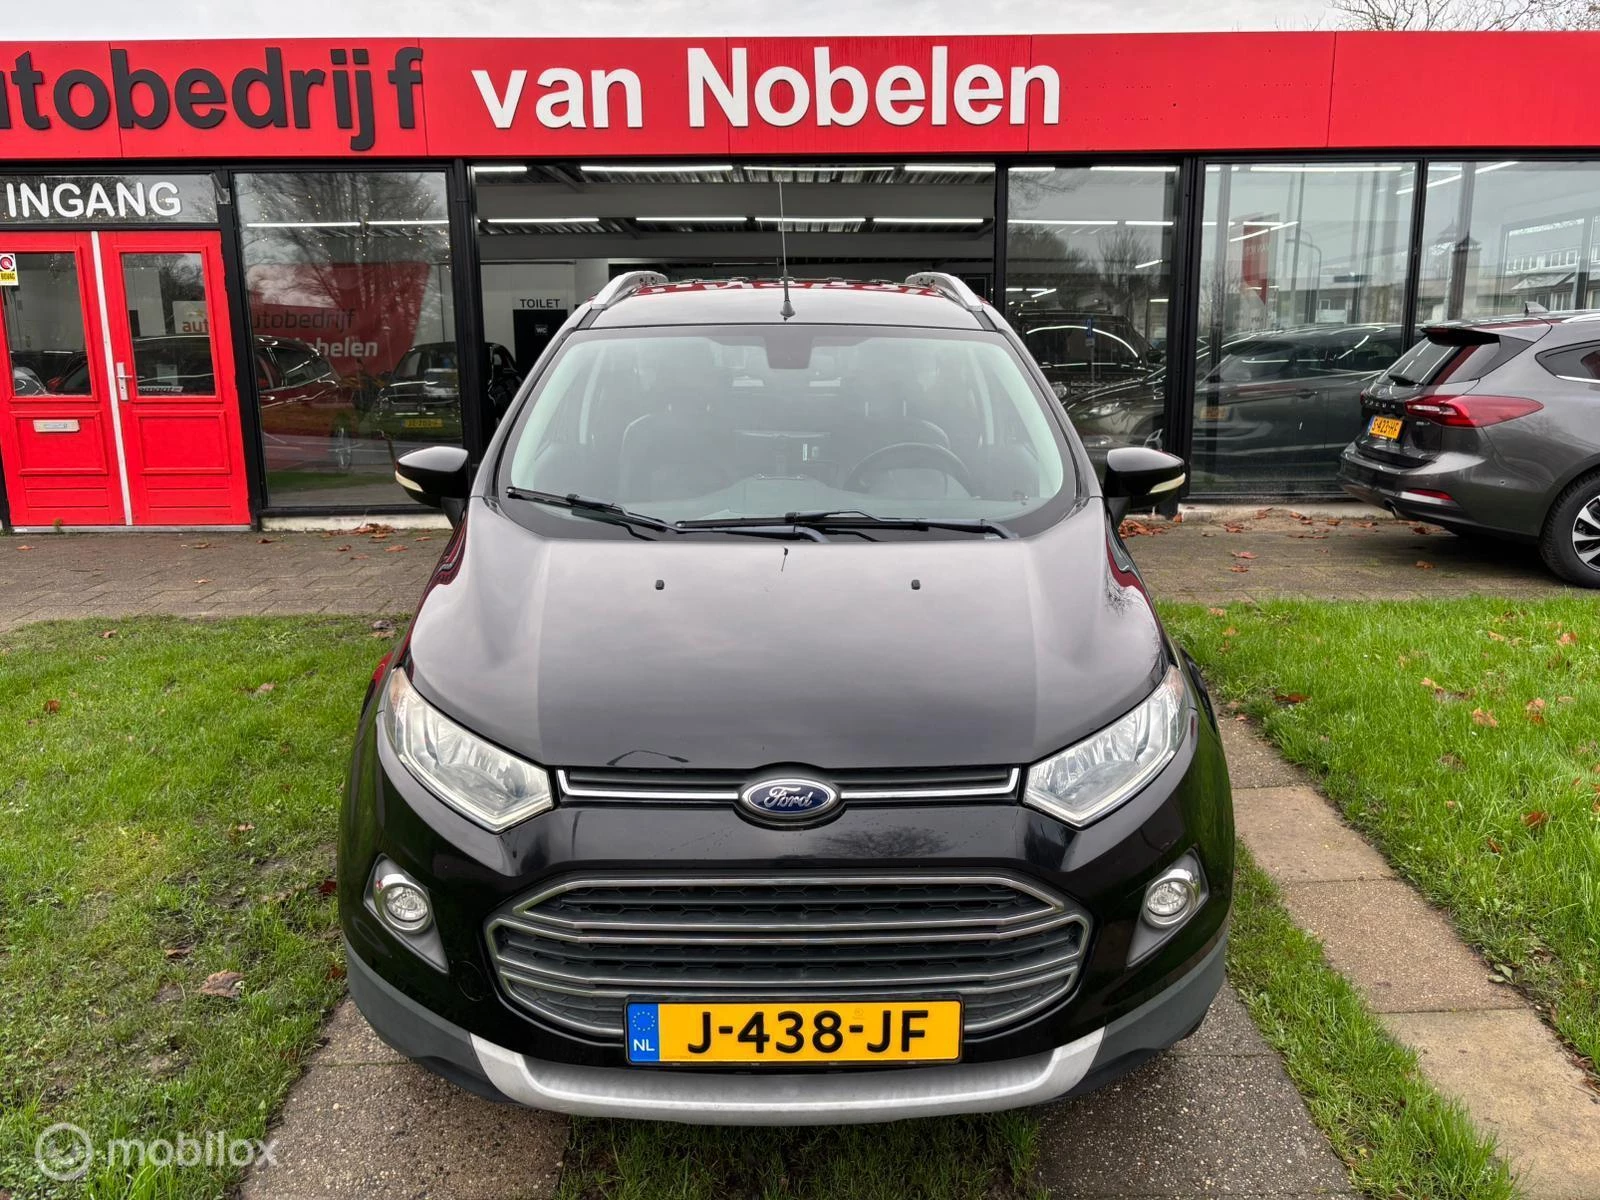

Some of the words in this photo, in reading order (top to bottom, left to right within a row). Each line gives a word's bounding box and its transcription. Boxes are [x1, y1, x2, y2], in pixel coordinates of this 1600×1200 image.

[471, 67, 643, 128] van
[687, 46, 1060, 127] Nobelen
[6, 181, 182, 218] INGANG
[519, 298, 561, 309] TOILET
[764, 785, 814, 808] Ford
[633, 1038, 656, 1053] NL
[687, 1009, 930, 1054] J-438-JF
